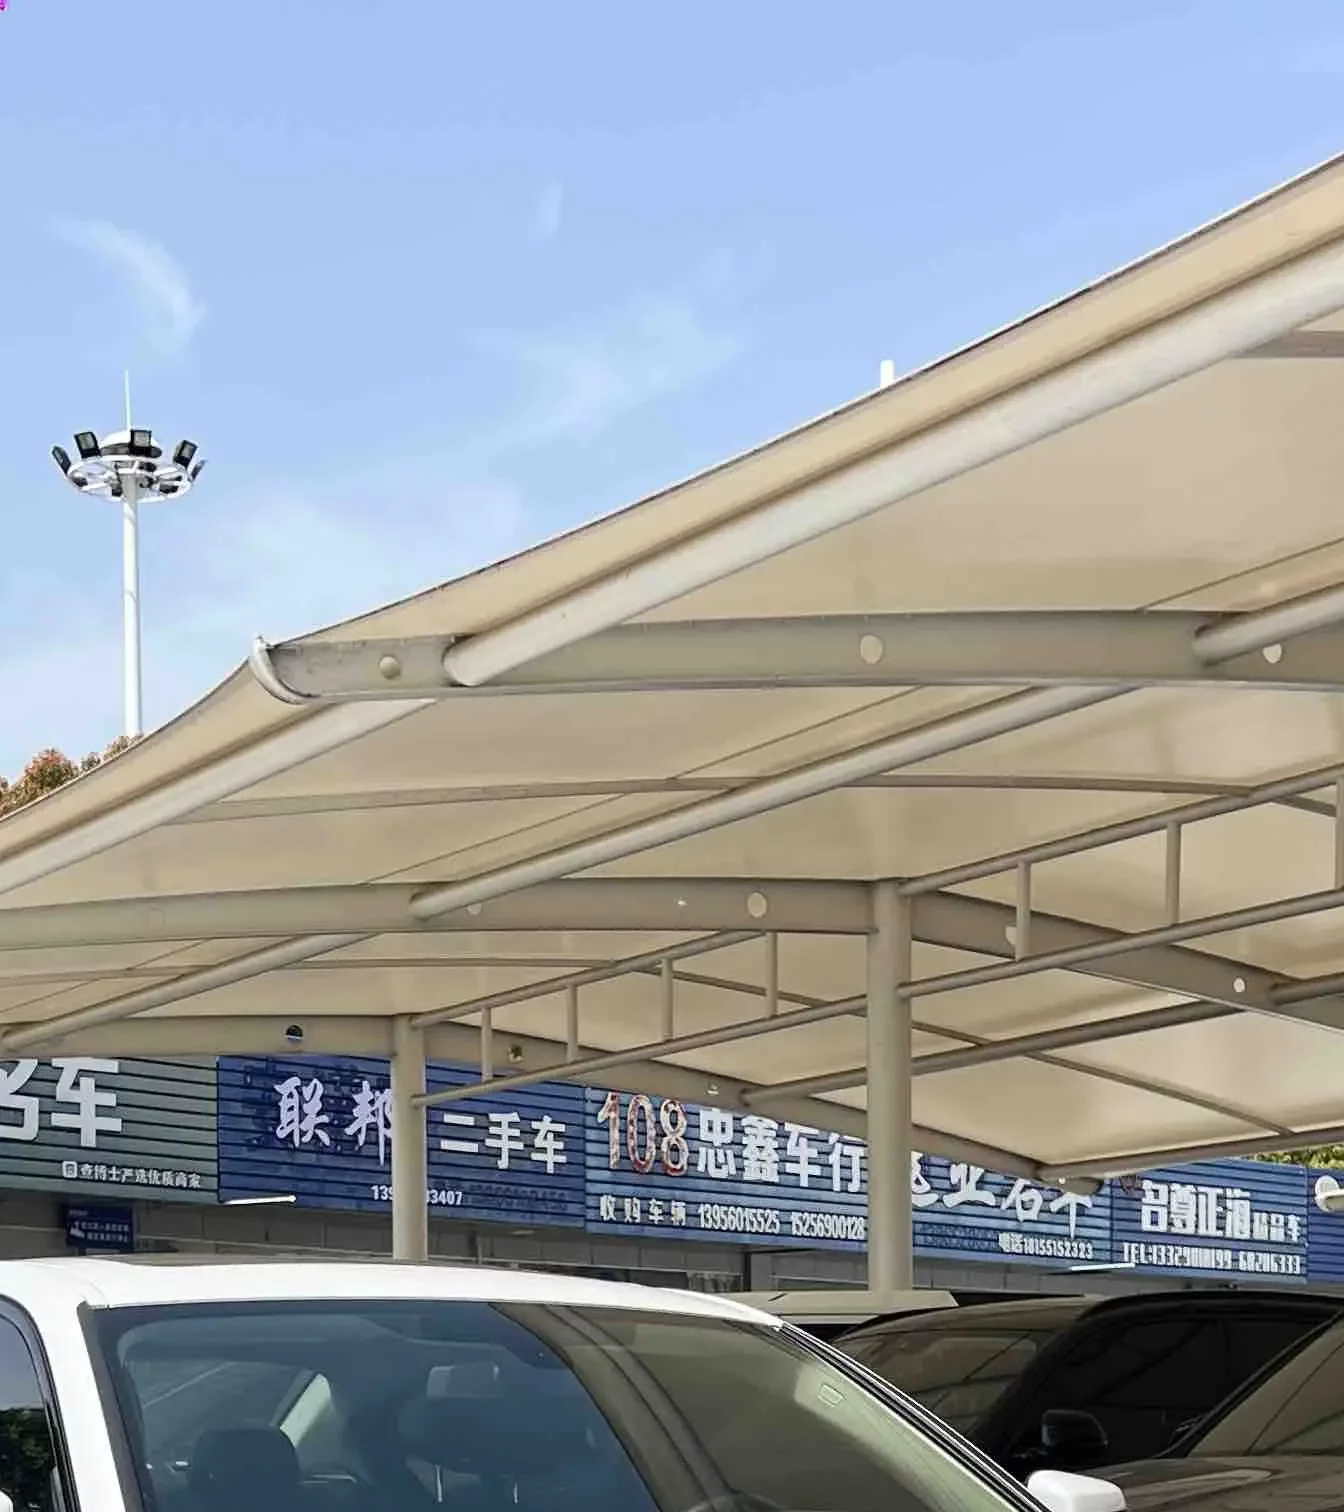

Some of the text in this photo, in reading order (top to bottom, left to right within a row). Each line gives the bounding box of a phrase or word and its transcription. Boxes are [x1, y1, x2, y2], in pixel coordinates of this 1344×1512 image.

[440, 1112, 567, 1174] 二手车
[597, 1091, 690, 1177] 108
[599, 1194, 687, 1227] 收购车辆
